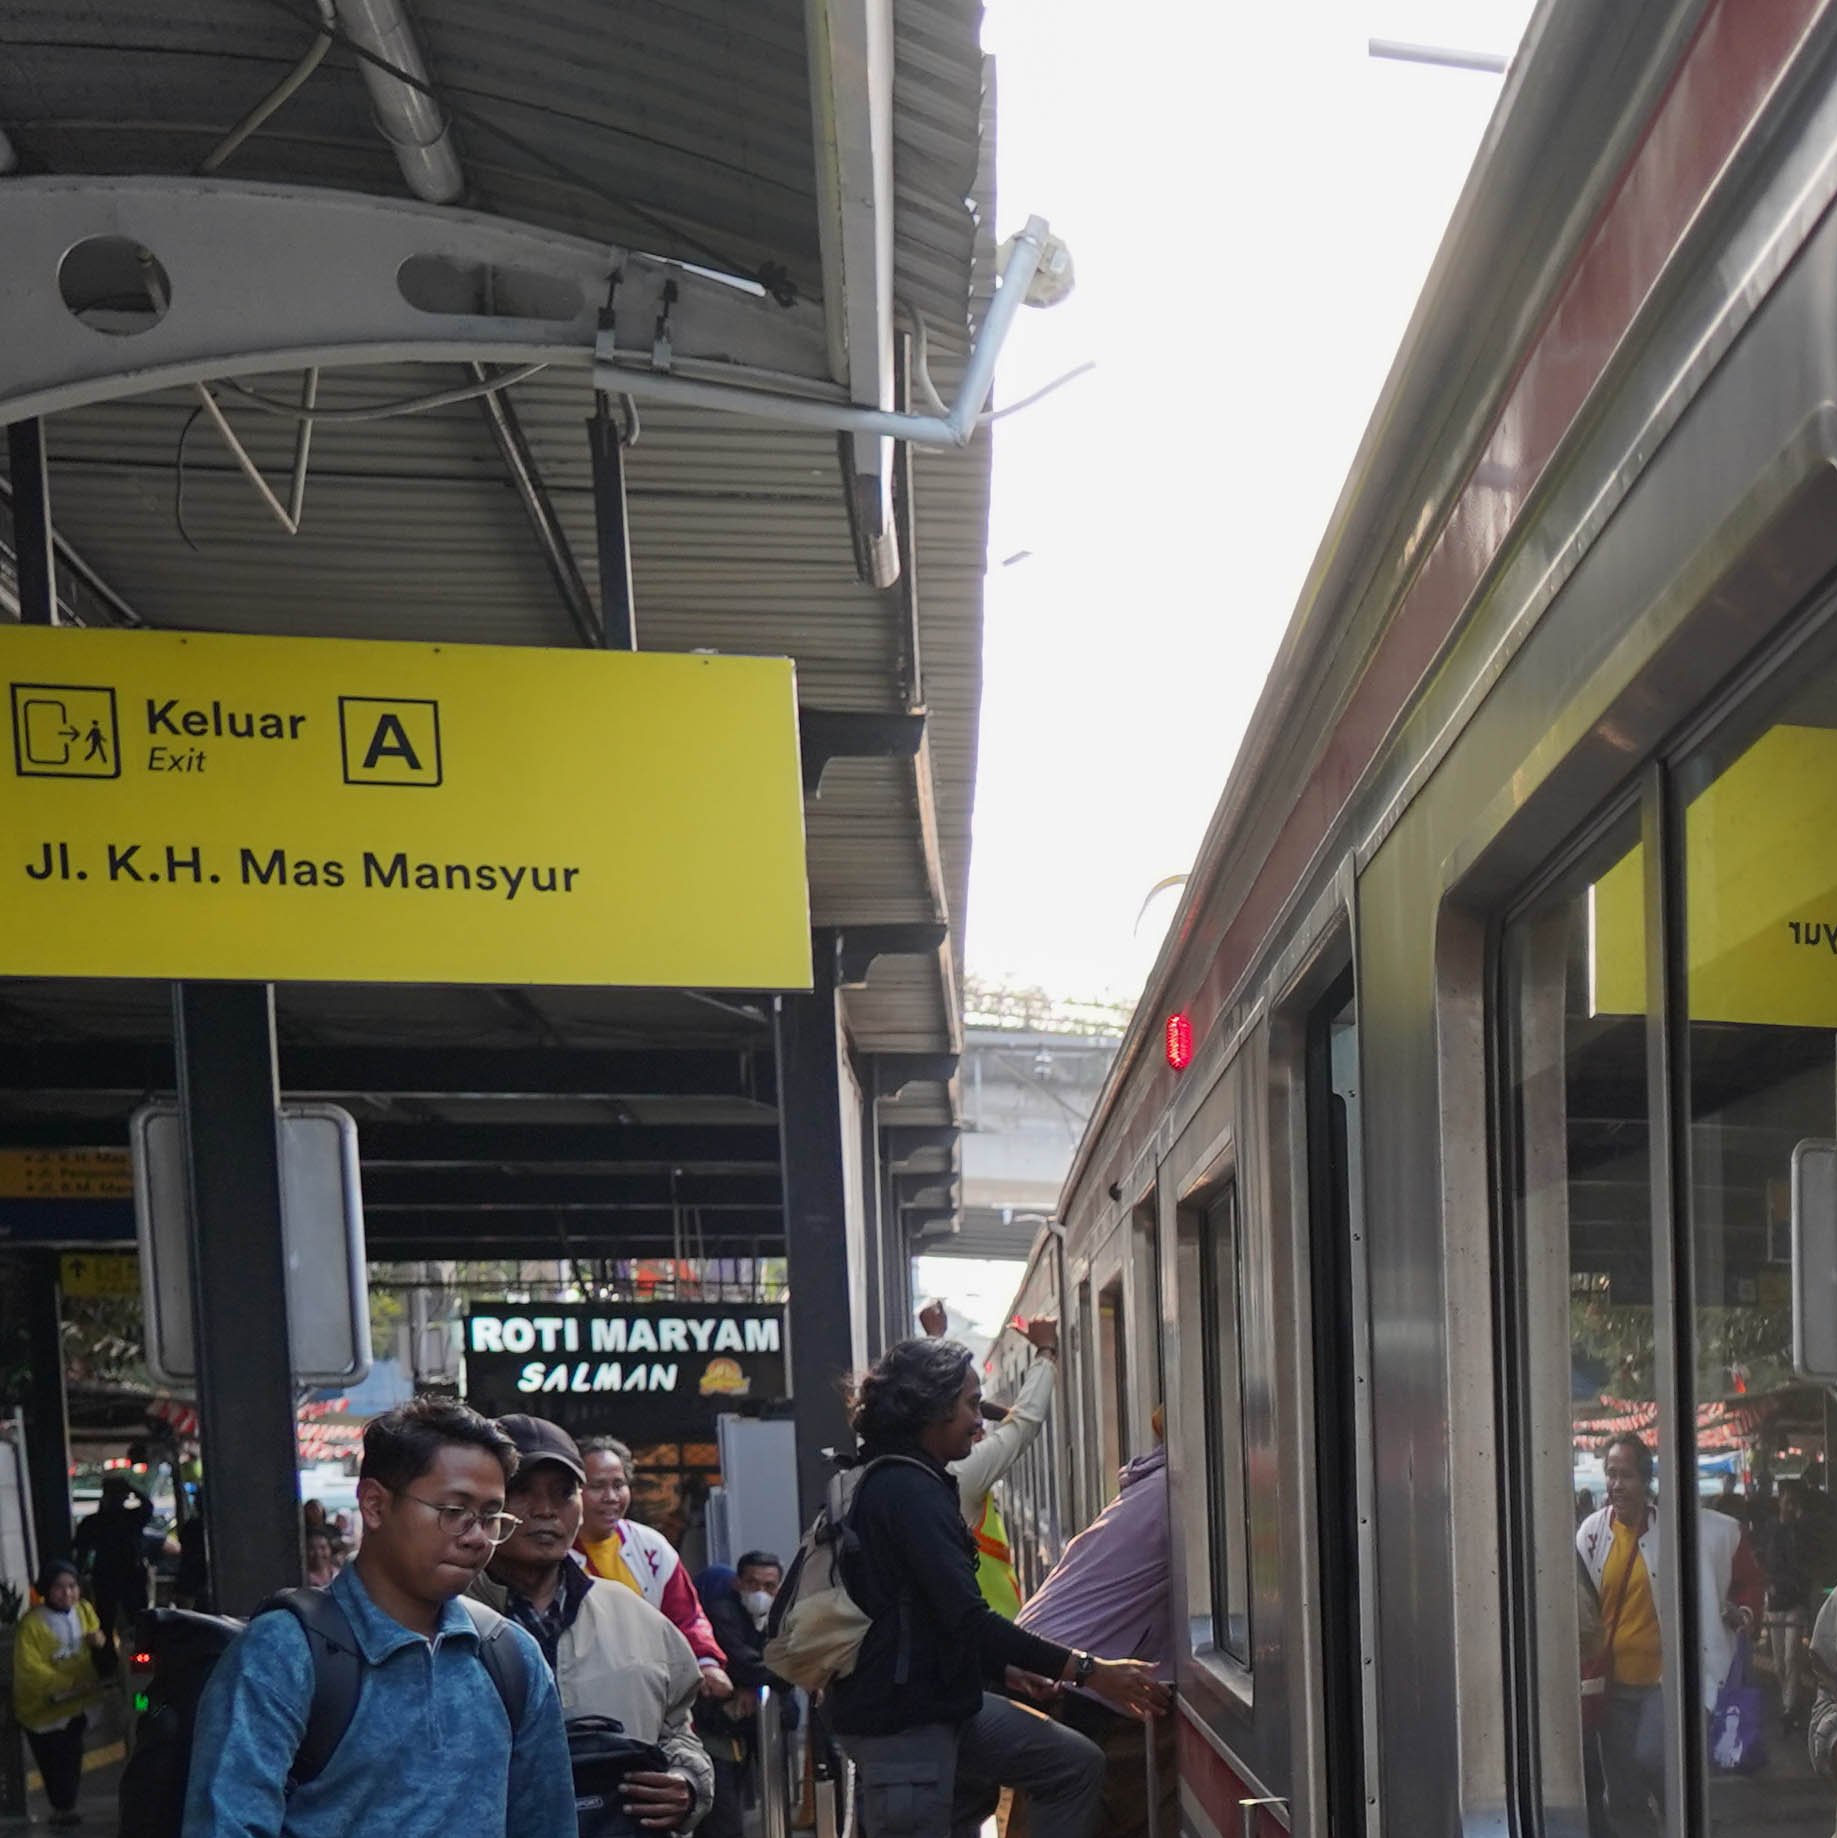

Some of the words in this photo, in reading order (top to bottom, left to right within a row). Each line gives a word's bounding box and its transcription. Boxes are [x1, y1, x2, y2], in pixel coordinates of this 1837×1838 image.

[146, 699, 307, 740] Keluar
[147, 746, 208, 773] Exit
[362, 713, 424, 770] A
[25, 842, 88, 881] Jl.
[107, 844, 221, 884] K.H.
[239, 848, 346, 888] Mas
[362, 852, 581, 901] Mansyur
[471, 1316, 580, 1353] ROTI
[590, 1317, 780, 1353] MARYAM
[516, 1361, 679, 1393] SALMAN
